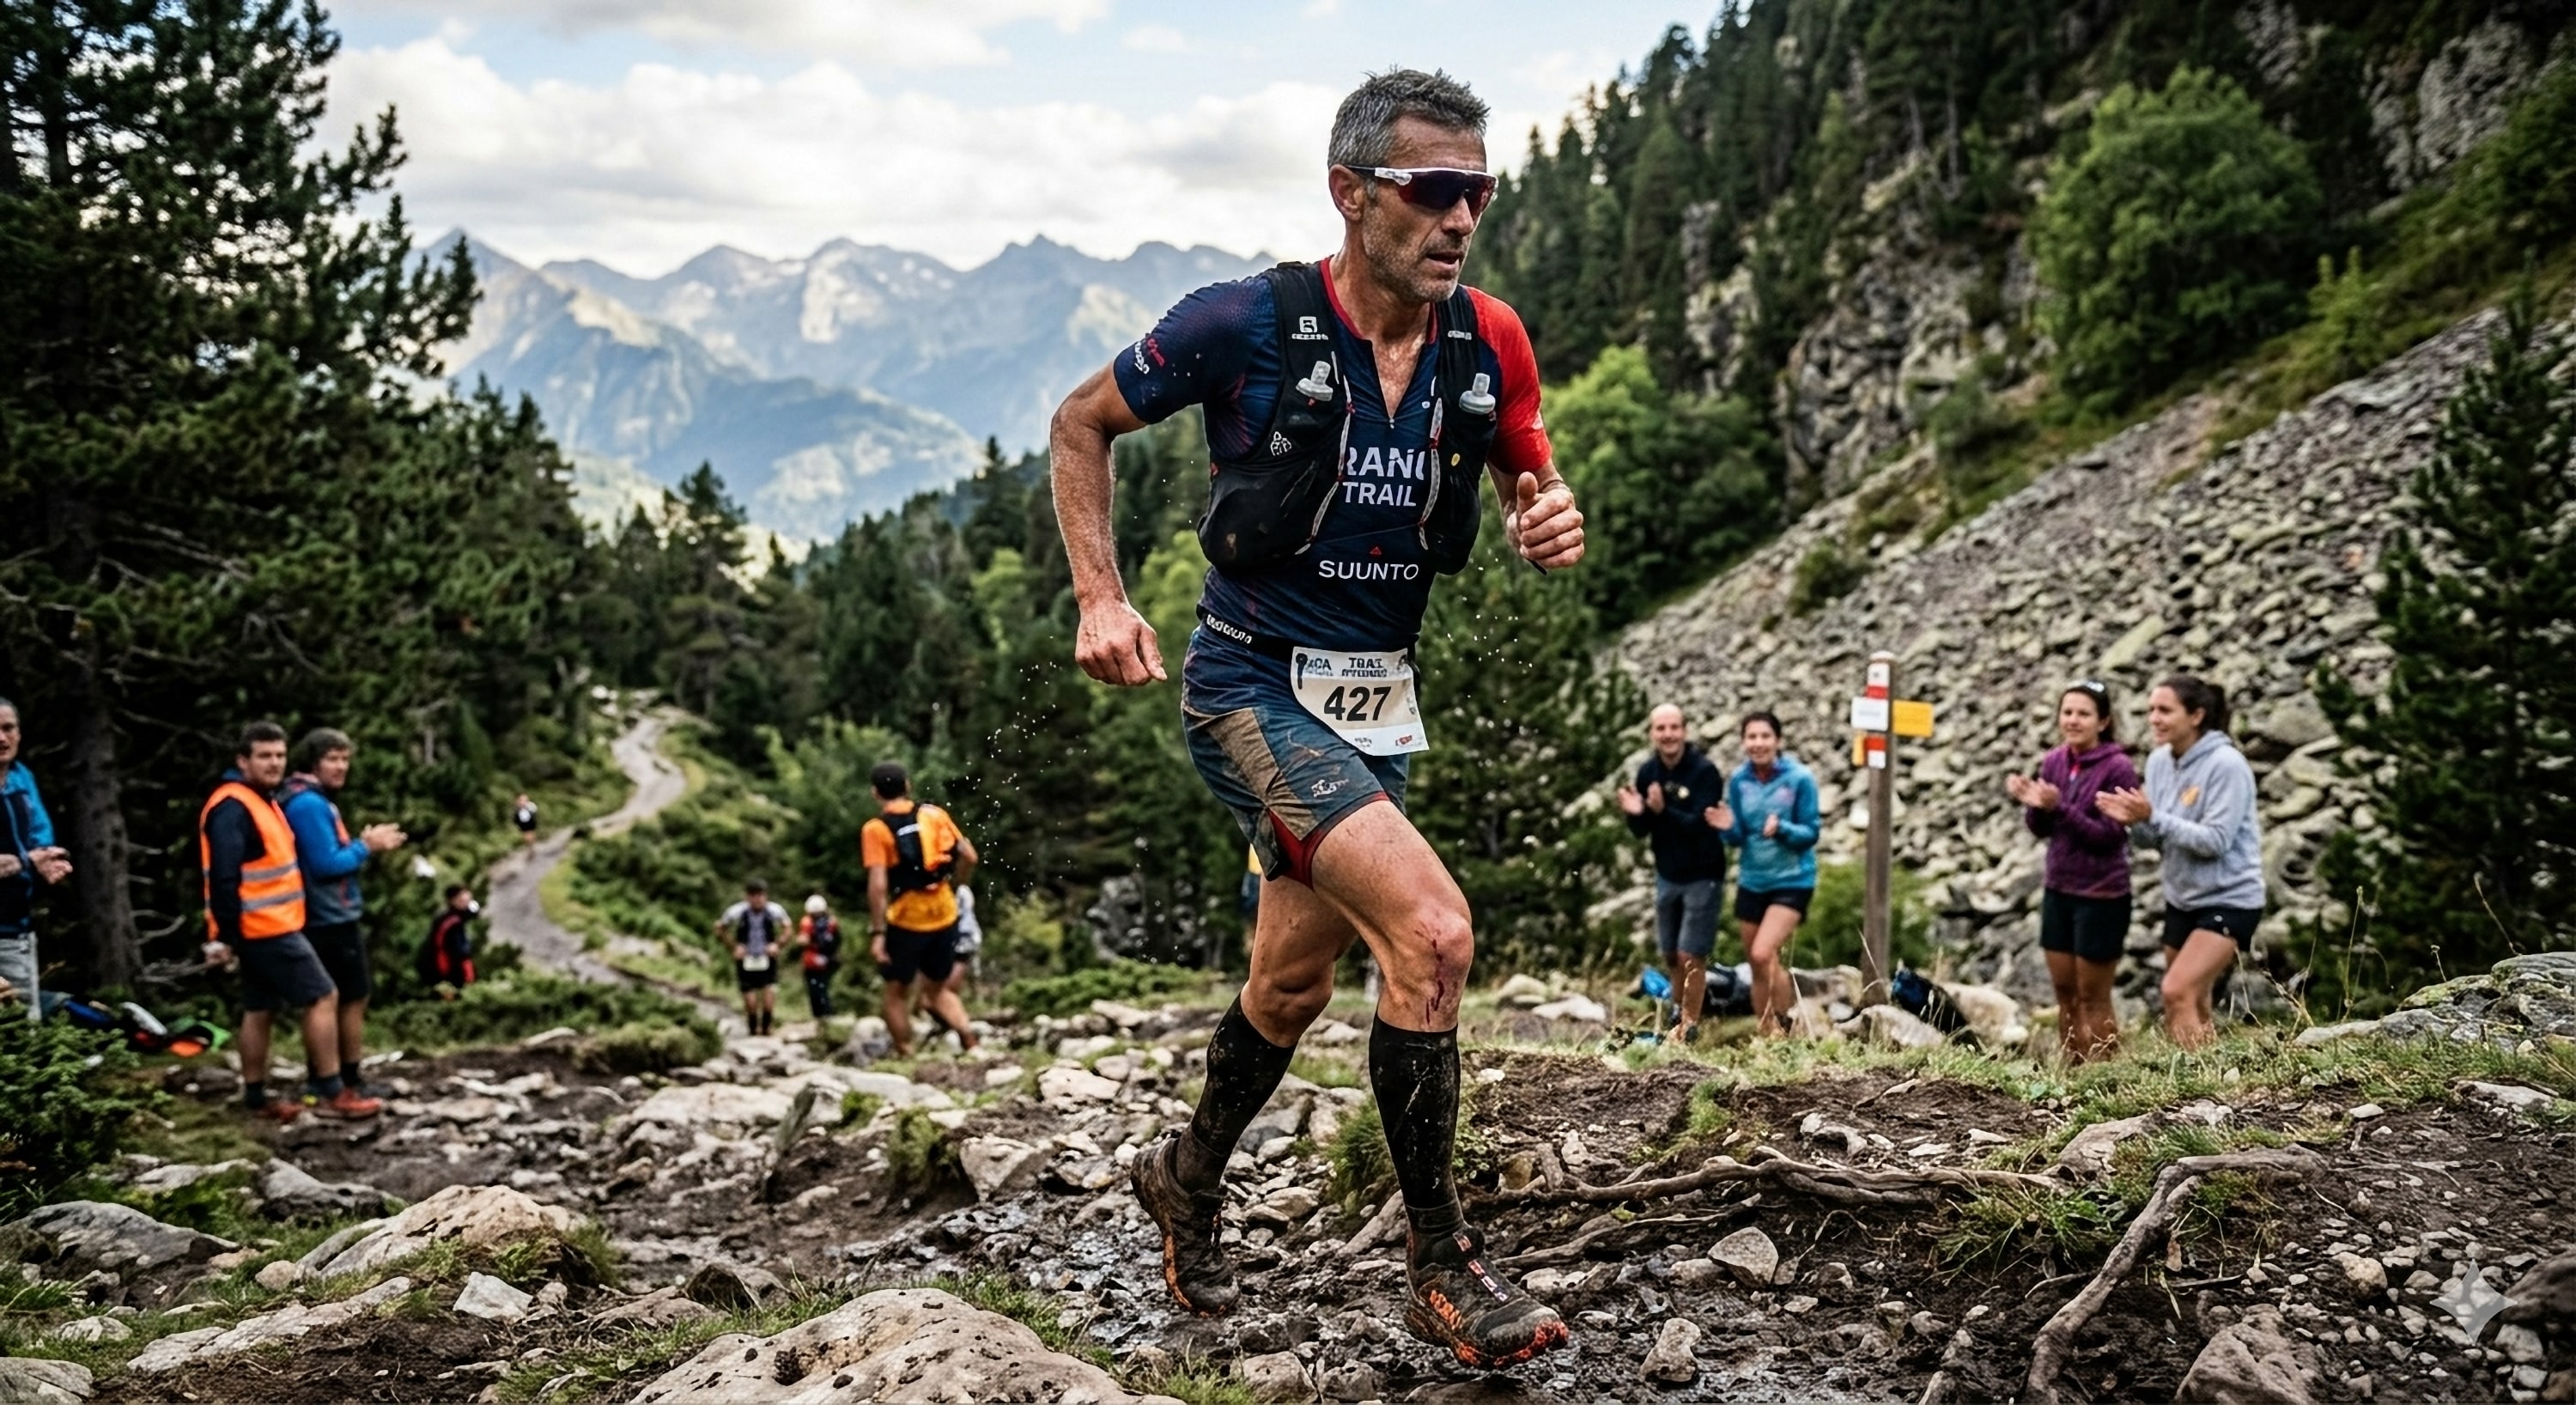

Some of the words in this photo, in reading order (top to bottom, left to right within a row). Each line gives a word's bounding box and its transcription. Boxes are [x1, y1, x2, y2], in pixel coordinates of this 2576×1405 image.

[1342, 481, 1417, 507] TRAIL
[1318, 560, 1419, 581] SUUNTO
[1323, 685, 1392, 721] 427
